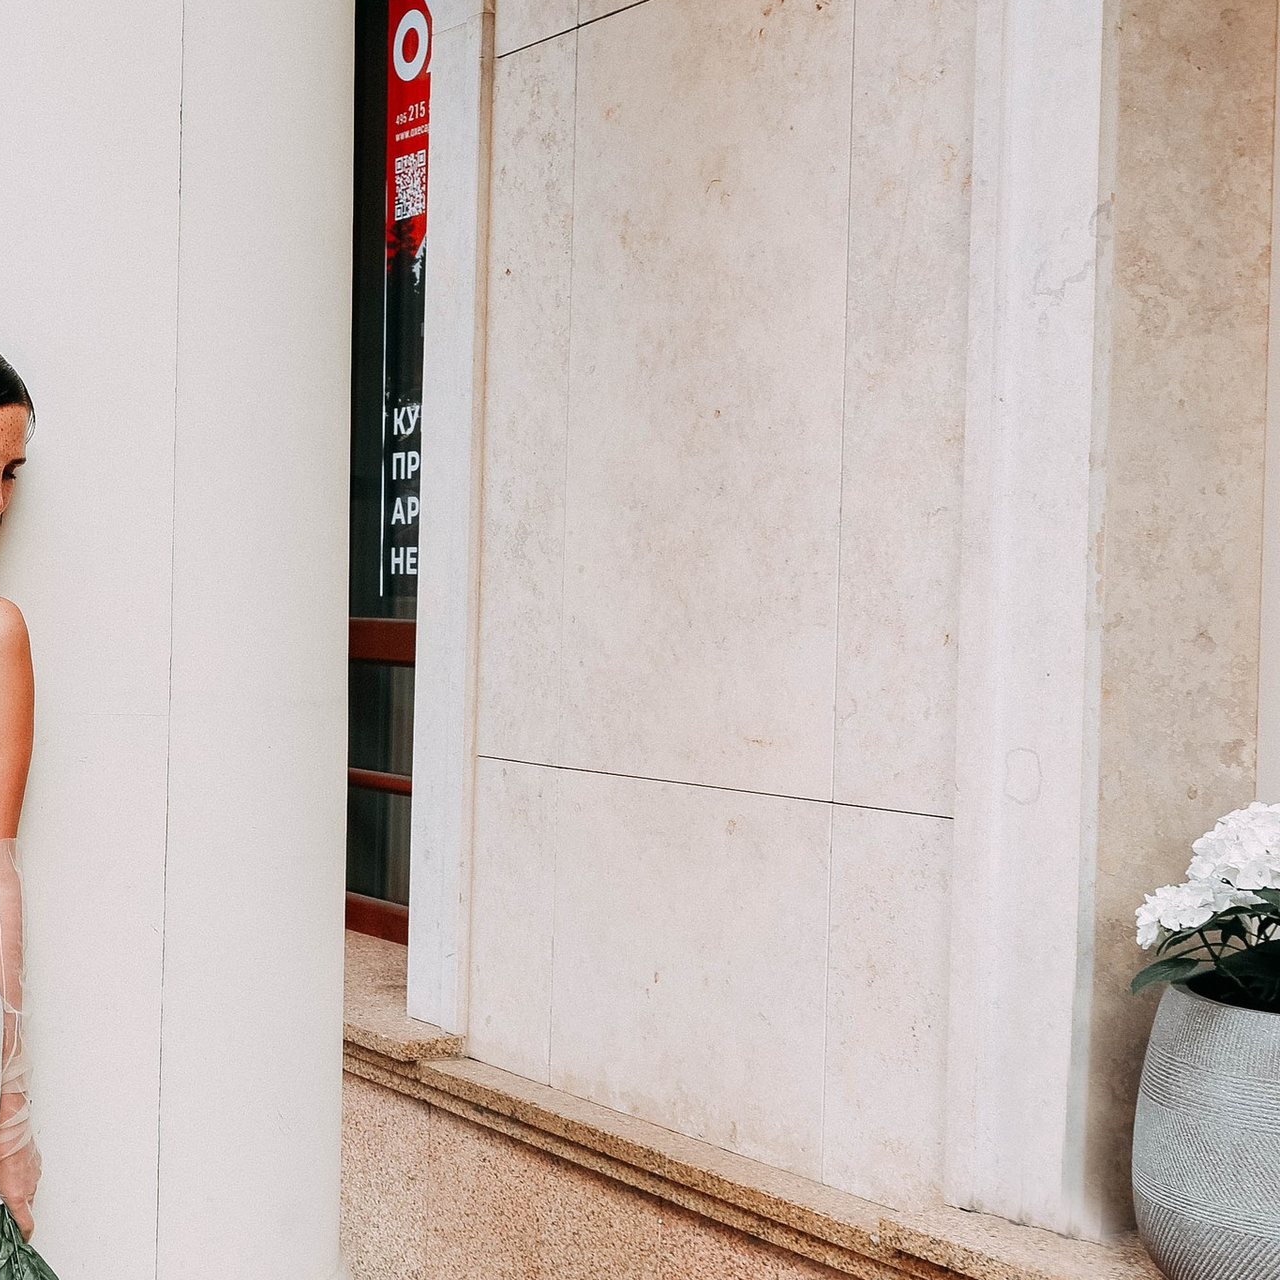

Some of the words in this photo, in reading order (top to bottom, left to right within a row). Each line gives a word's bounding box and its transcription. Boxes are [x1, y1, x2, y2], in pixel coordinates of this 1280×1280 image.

[396, 112, 407, 125] 495
[408, 101, 425, 121] 215
[393, 406, 420, 435] КУ
[392, 451, 420, 480] ПР
[391, 496, 419, 525] АР
[391, 547, 418, 575] НЕ
